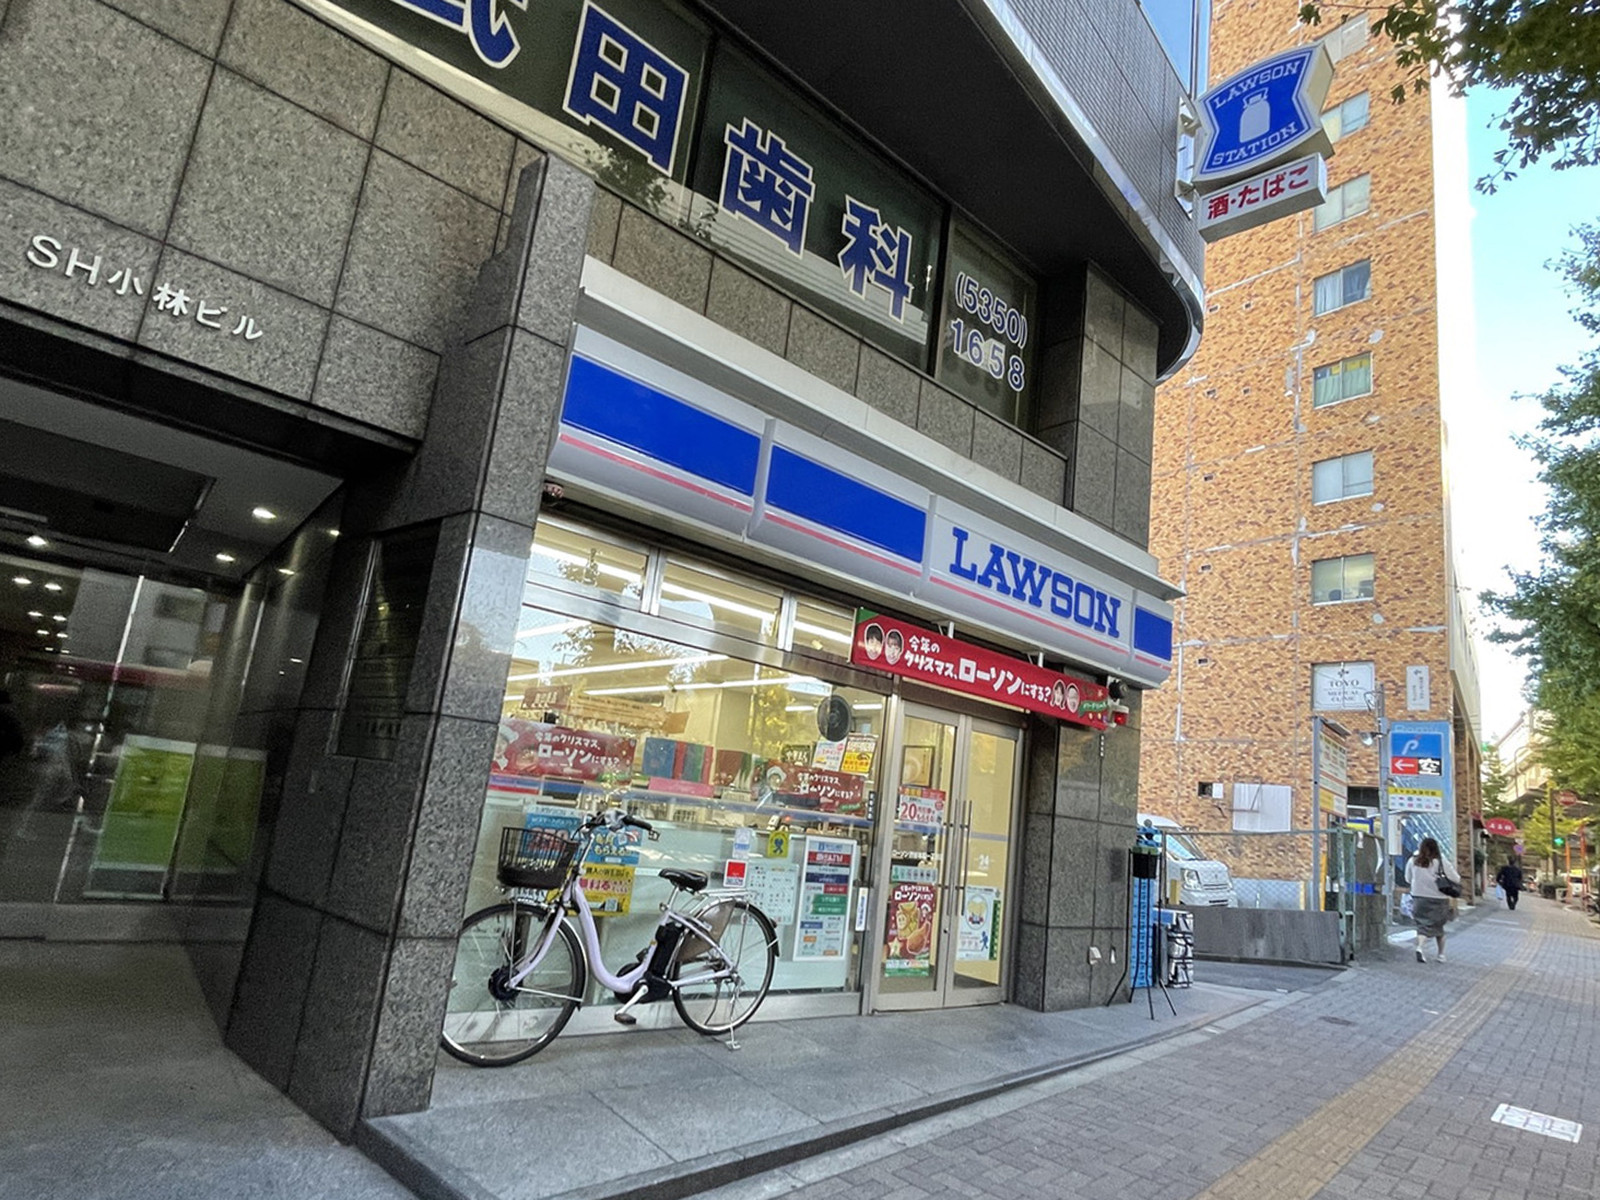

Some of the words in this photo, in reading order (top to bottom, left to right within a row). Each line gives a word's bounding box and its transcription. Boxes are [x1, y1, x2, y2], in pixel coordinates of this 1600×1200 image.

[1213, 60, 1301, 109] LAWSON
[392, 0, 915, 324] 田歯科
[1211, 121, 1298, 166] STATION
[1207, 165, 1309, 220] 酒・たばこ
[27, 234, 263, 340] SH小林ビル
[955, 271, 1028, 349] (5350)
[951, 318, 1026, 392] 1658
[950, 526, 1121, 638] LAWSON
[908, 634, 940, 654] 今年の
[1418, 757, 1440, 776] 空
[901, 802, 918, 820] 20
